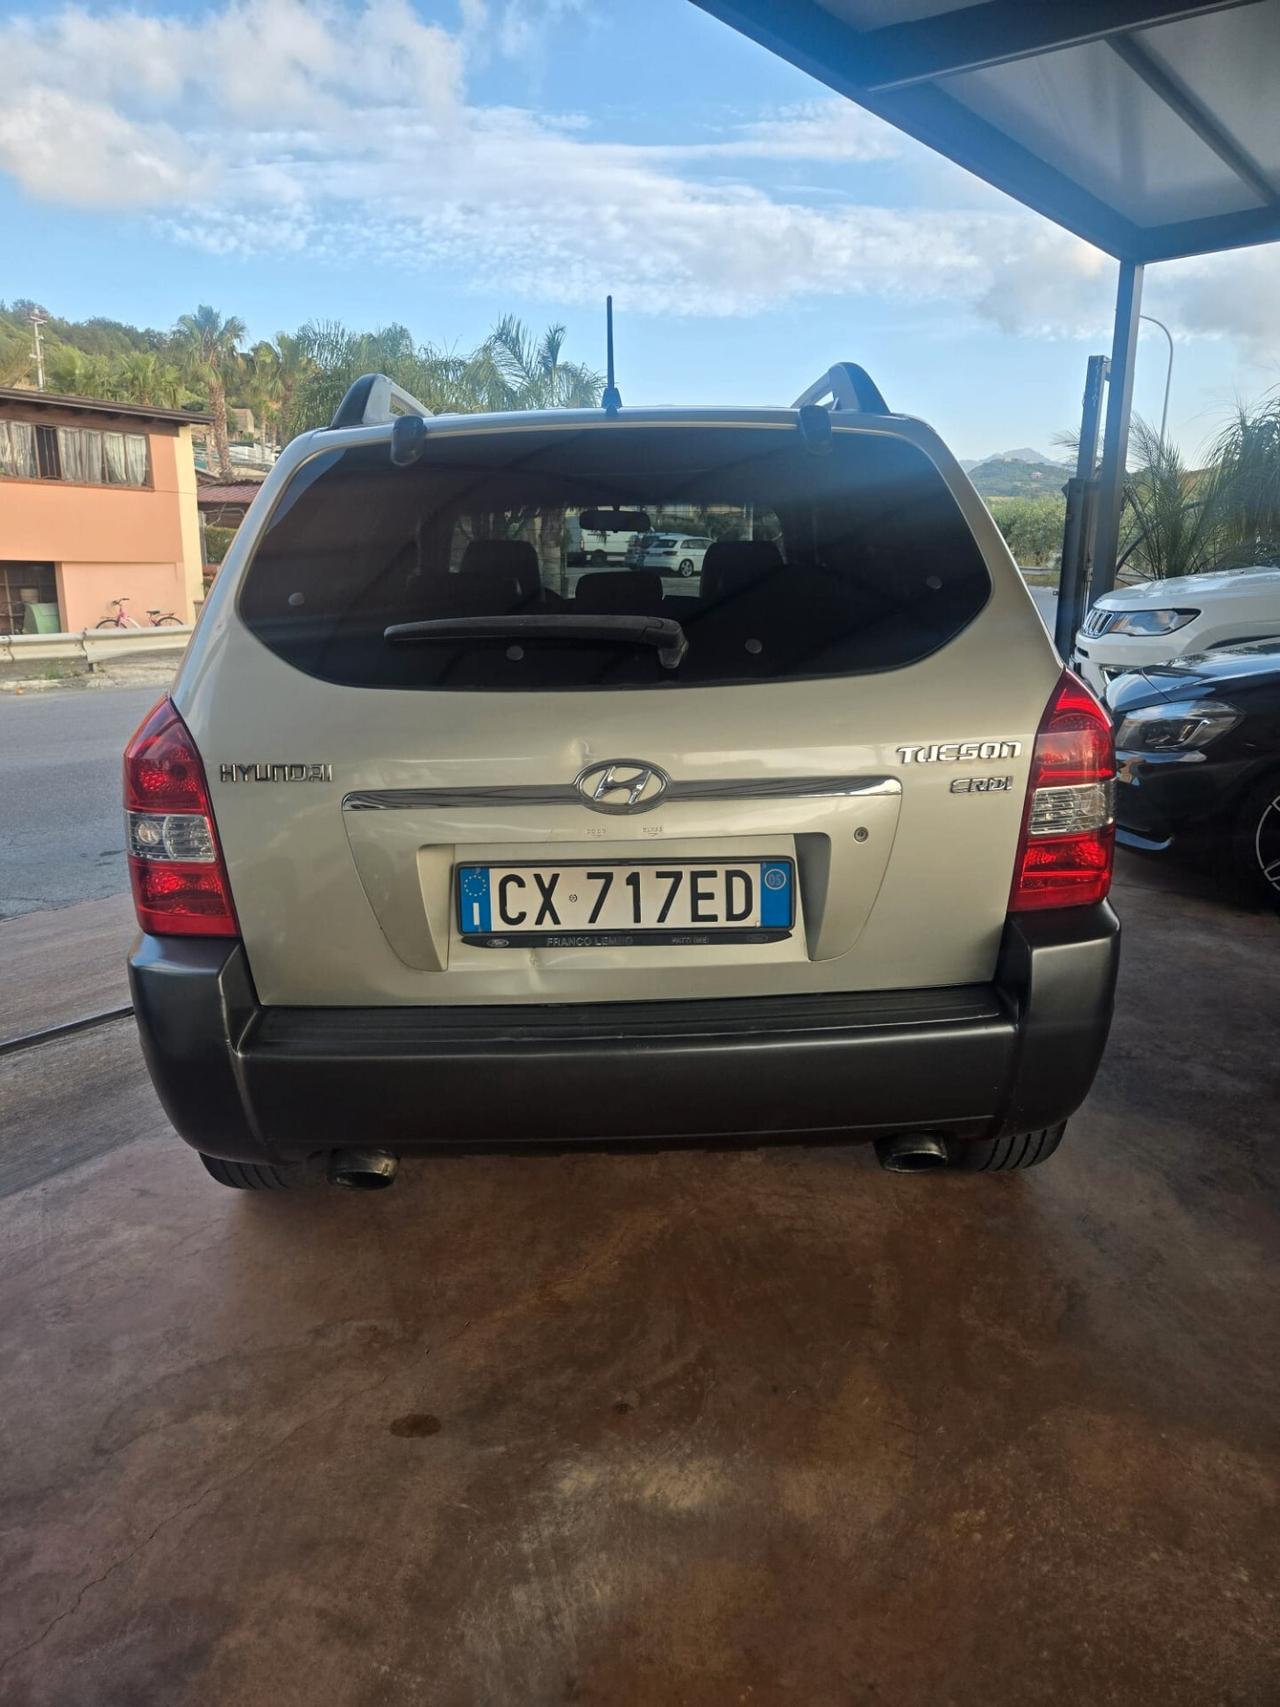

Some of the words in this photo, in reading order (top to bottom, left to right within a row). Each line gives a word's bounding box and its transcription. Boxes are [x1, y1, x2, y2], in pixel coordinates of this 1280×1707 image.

[896, 741, 1021, 764] TUCSON
[220, 763, 334, 782] HYUNDAI
[499, 873, 561, 926] CX
[586, 869, 753, 924] 717ED
[473, 902, 480, 926] I
[546, 936, 592, 947] FRANCO
